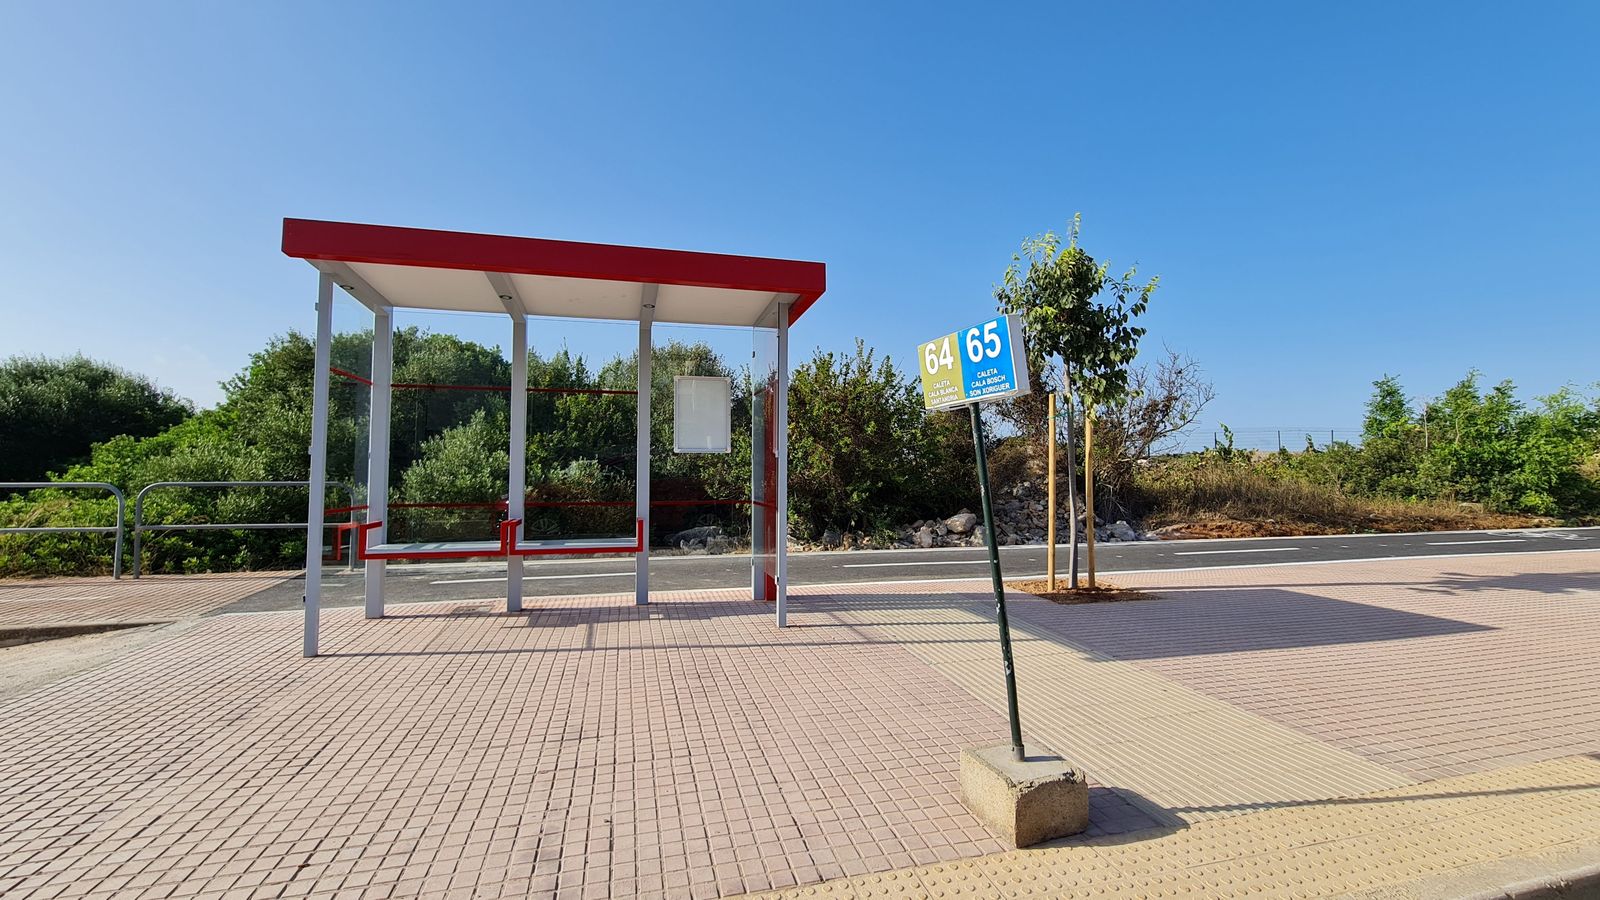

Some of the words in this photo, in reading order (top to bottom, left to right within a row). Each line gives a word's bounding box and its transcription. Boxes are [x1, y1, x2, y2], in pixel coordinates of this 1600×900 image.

[966, 320, 1001, 363] 65
[925, 337, 953, 375] 64
[977, 368, 998, 379] CALETA
[933, 380, 950, 389] CALETA
[971, 379, 986, 388] CALA
[987, 375, 1006, 385] BOSCH
[928, 389, 940, 397] CALA
[940, 386, 958, 396] BLANCA
[969, 388, 982, 397] SON
[982, 382, 1010, 394] XORIGUER
